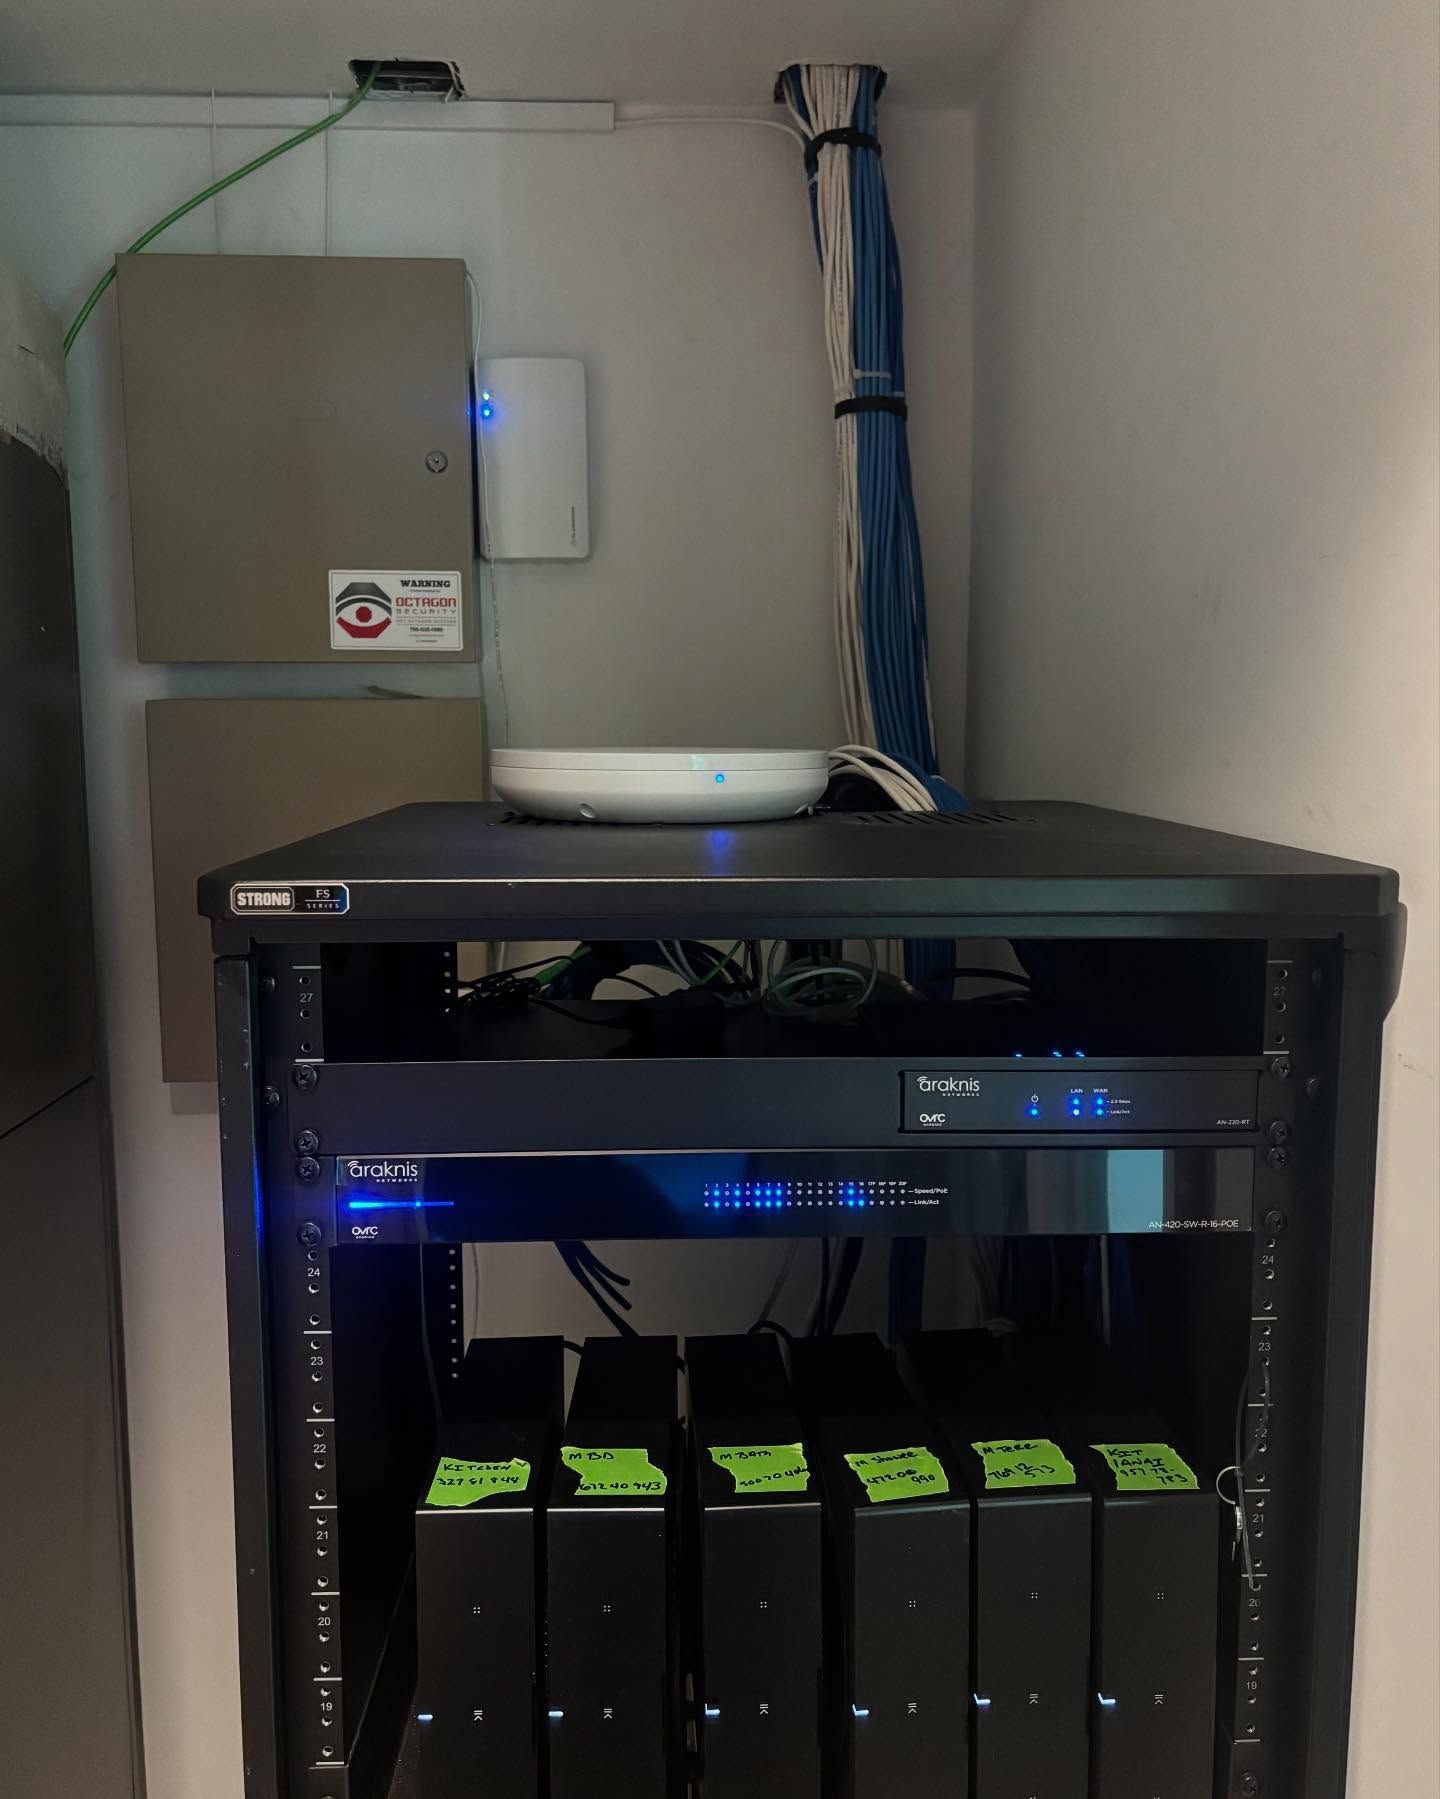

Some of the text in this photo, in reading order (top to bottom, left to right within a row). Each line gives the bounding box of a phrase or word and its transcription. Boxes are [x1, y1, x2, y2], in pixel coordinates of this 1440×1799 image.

[400, 580, 451, 588] WARNING
[395, 597, 457, 608] OCTAGON
[237, 892, 291, 906] STRONG
[315, 889, 330, 899] FS
[1273, 986, 1286, 997] 27
[300, 992, 314, 1002] 27
[919, 1076, 980, 1092] araknis
[349, 1161, 418, 1178] araknis
[914, 1187, 949, 1195] Speed/PoE
[1148, 1219, 1240, 1229] AN-420-SW-R-16-POE
[1262, 1255, 1275, 1265] 24
[307, 1267, 321, 1277] 24
[1258, 1342, 1271, 1351] 23
[310, 1356, 324, 1366] 23
[313, 1443, 327, 1453] 22
[981, 1445, 996, 1455] M
[568, 1452, 582, 1460] M
[609, 1482, 629, 1490] 40
[1252, 1513, 1264, 1523] 21
[316, 1530, 329, 1540] 21
[318, 1616, 331, 1626] 20
[1246, 1680, 1257, 1690] 19
[320, 1702, 333, 1712] 19
